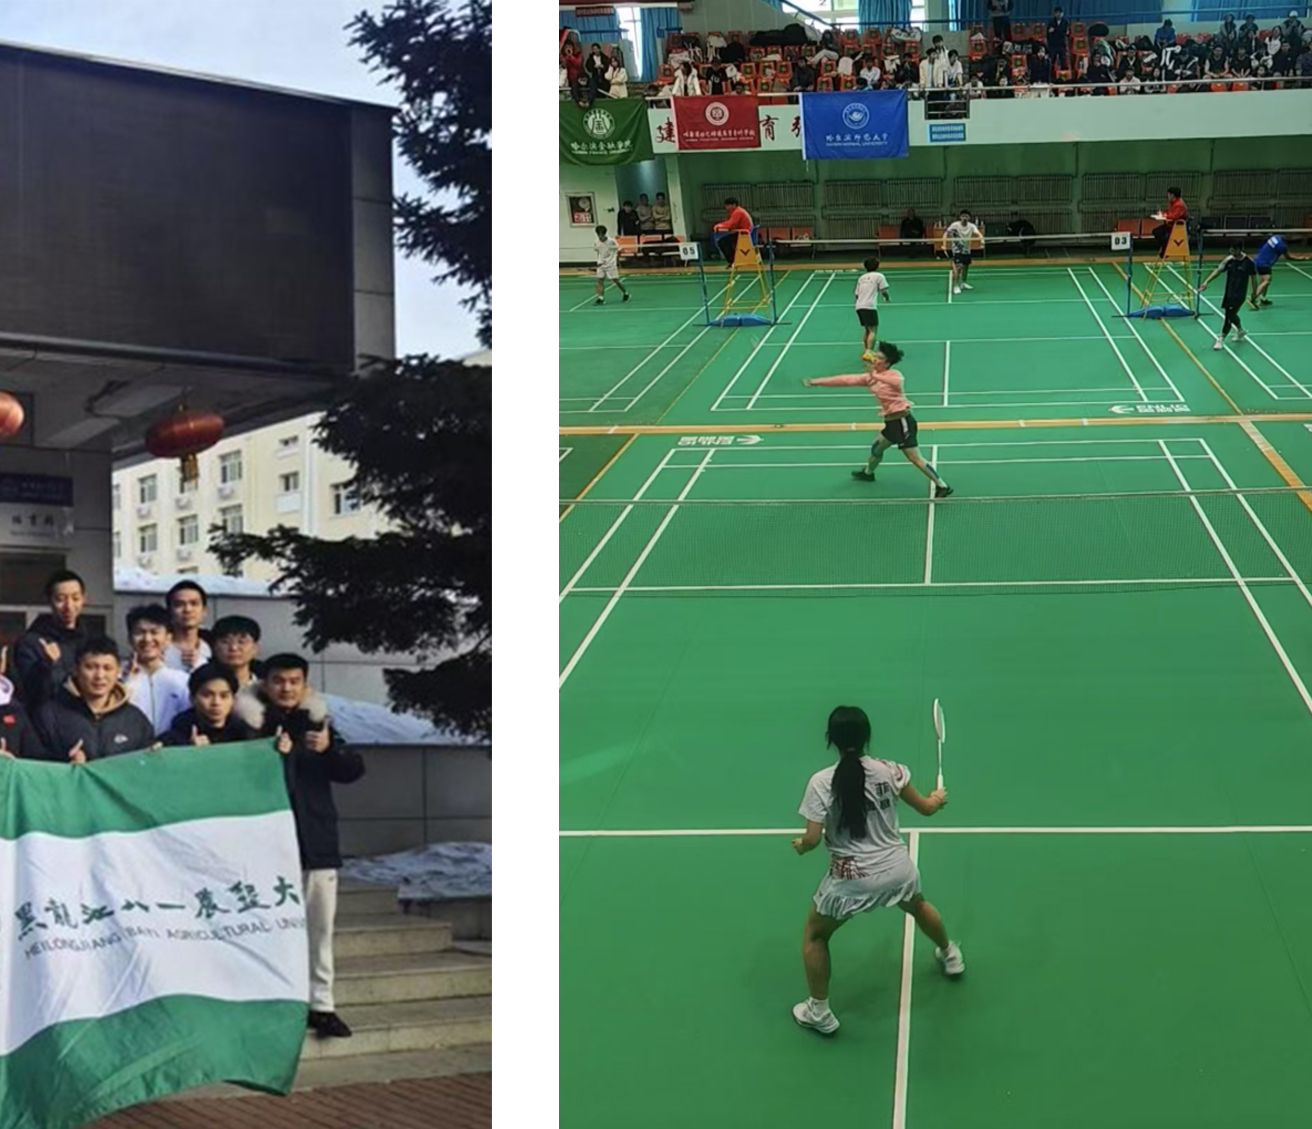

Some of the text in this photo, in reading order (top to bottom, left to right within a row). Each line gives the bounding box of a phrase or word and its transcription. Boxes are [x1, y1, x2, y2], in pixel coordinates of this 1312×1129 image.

[1114, 236, 1128, 246] 03
[682, 247, 695, 256] 05
[24, 931, 123, 960] HEILONGJIANG
[166, 920, 273, 942] AGRICULTURAL
